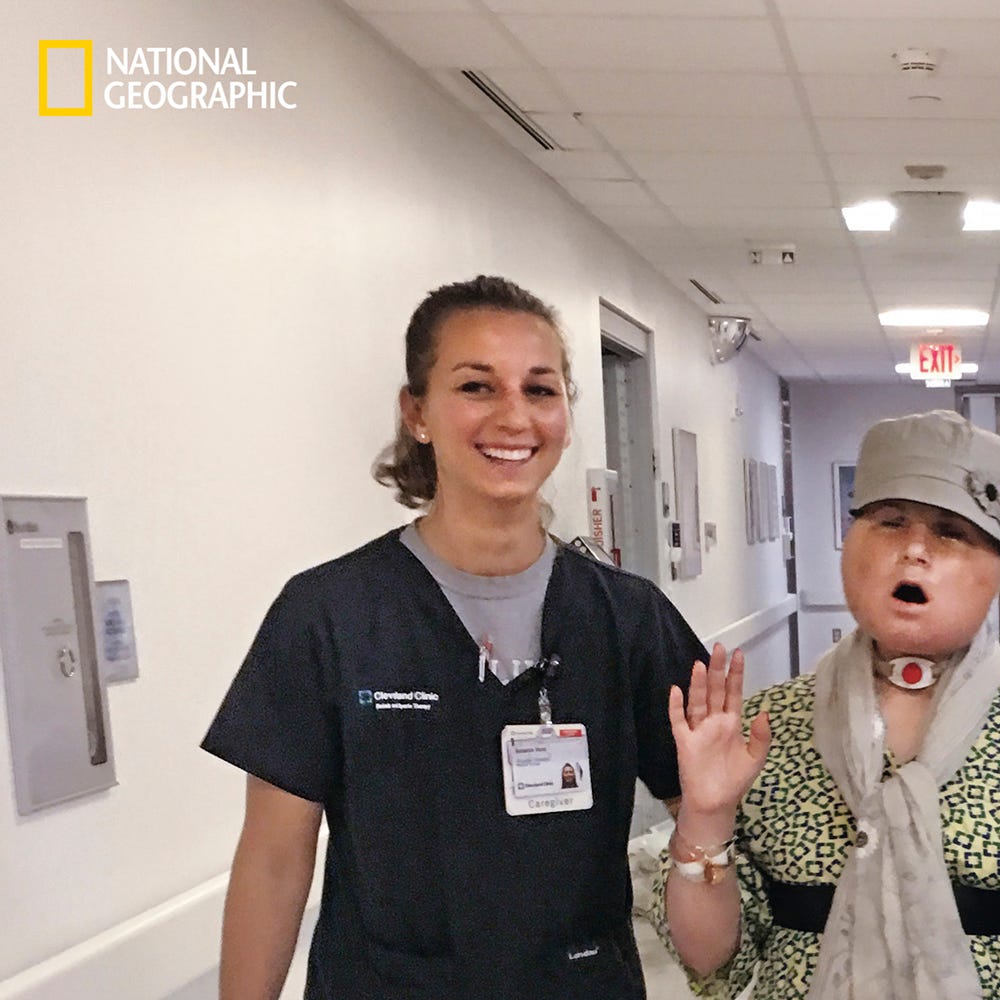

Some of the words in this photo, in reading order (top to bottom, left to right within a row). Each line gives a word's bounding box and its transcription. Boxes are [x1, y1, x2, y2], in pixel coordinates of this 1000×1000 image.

[919, 344, 954, 373] EXIT
[374, 691, 413, 700] Cleveland
[414, 691, 439, 700] Clinic
[528, 798, 574, 808] Caregiver
